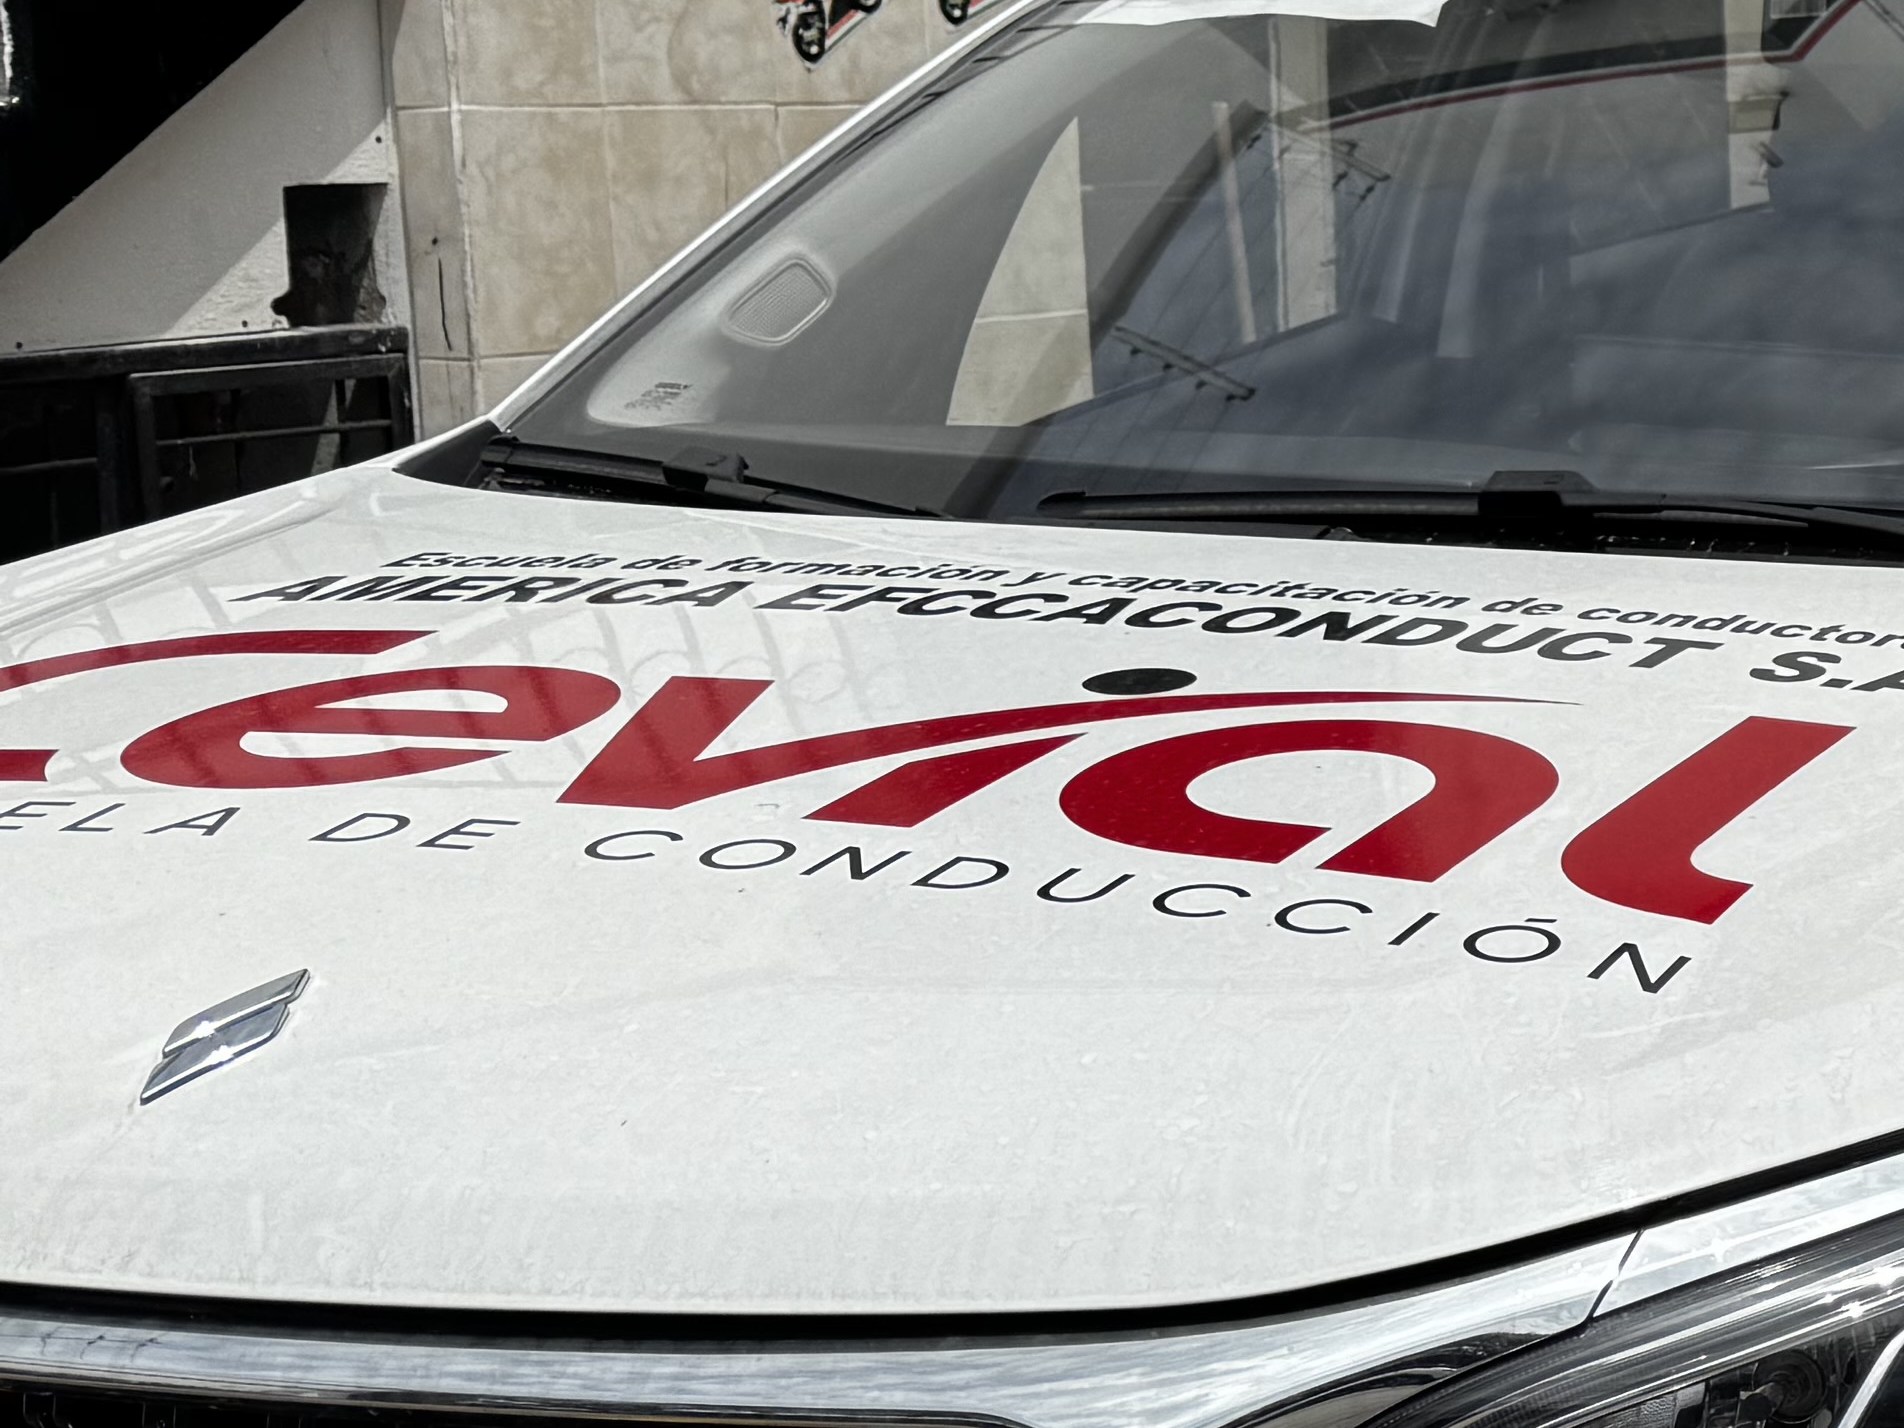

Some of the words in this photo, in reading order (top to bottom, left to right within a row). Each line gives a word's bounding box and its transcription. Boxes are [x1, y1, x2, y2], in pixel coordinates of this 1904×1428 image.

[227, 574, 754, 608] AMERICA
[380, 551, 617, 570] Escuela
[620, 554, 703, 572] de
[703, 556, 1011, 582] formación
[1000, 571, 1069, 587] y
[1067, 571, 1471, 610] capacitación
[1481, 596, 1565, 617] de
[308, 811, 520, 853] DE
[582, 828, 1694, 996] CONDUCCIÓN
